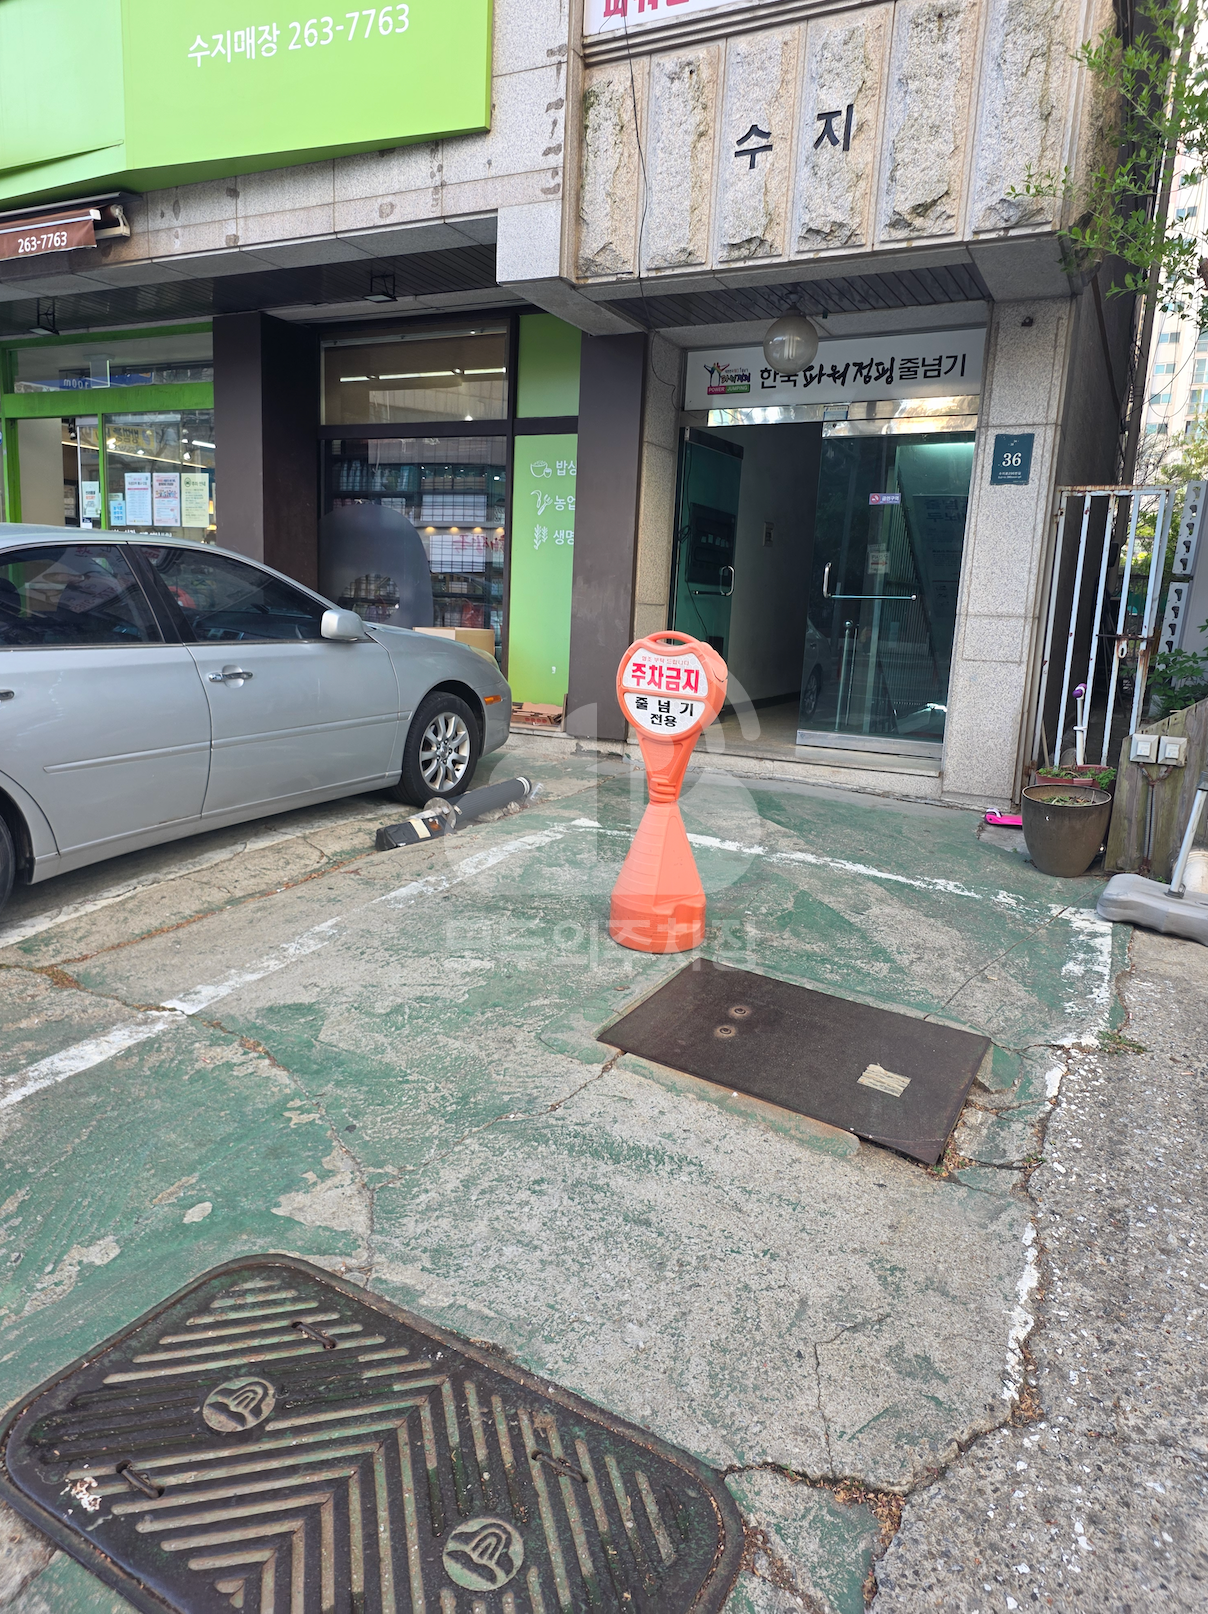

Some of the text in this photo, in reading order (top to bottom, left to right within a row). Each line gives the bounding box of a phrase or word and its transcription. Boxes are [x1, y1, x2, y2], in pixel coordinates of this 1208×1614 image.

[187, 3, 410, 68] 수지매장 263-7763
[17, 231, 68, 253] 263-7763
[1001, 452, 1022, 467] 36
[631, 662, 699, 694] 주차금지
[650, 713, 677, 728] 전용
